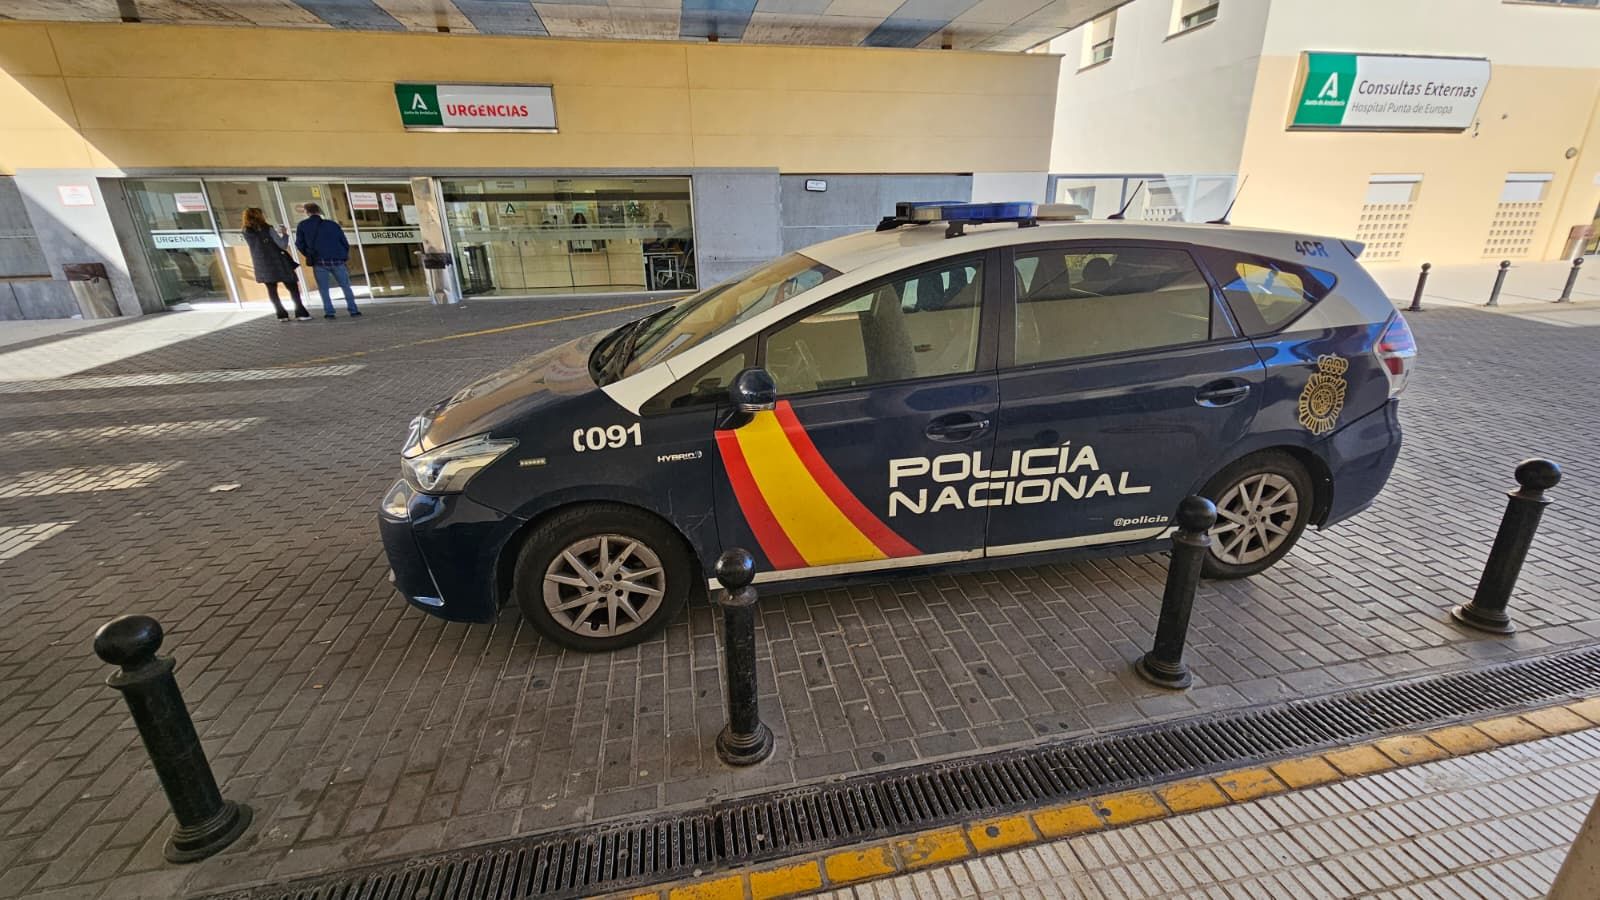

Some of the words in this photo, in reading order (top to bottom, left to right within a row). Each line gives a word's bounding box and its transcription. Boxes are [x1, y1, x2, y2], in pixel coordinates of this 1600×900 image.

[1358, 80, 1422, 96] Consultas
[1424, 82, 1478, 98] Externas
[446, 104, 529, 117] URGENCIAS
[1351, 101, 1386, 114] Hospital
[1387, 102, 1412, 113] Punta
[1412, 103, 1424, 113] de
[1424, 103, 1453, 115] Europa
[155, 235, 206, 244] URGENCIAS
[371, 231, 415, 240] URGENCIAS
[1294, 239, 1329, 257] 4CR
[585, 422, 643, 451] 091
[888, 440, 1100, 488] POLICÍA
[888, 471, 1152, 517] NACIONAL
[1113, 514, 1169, 527] @policia
